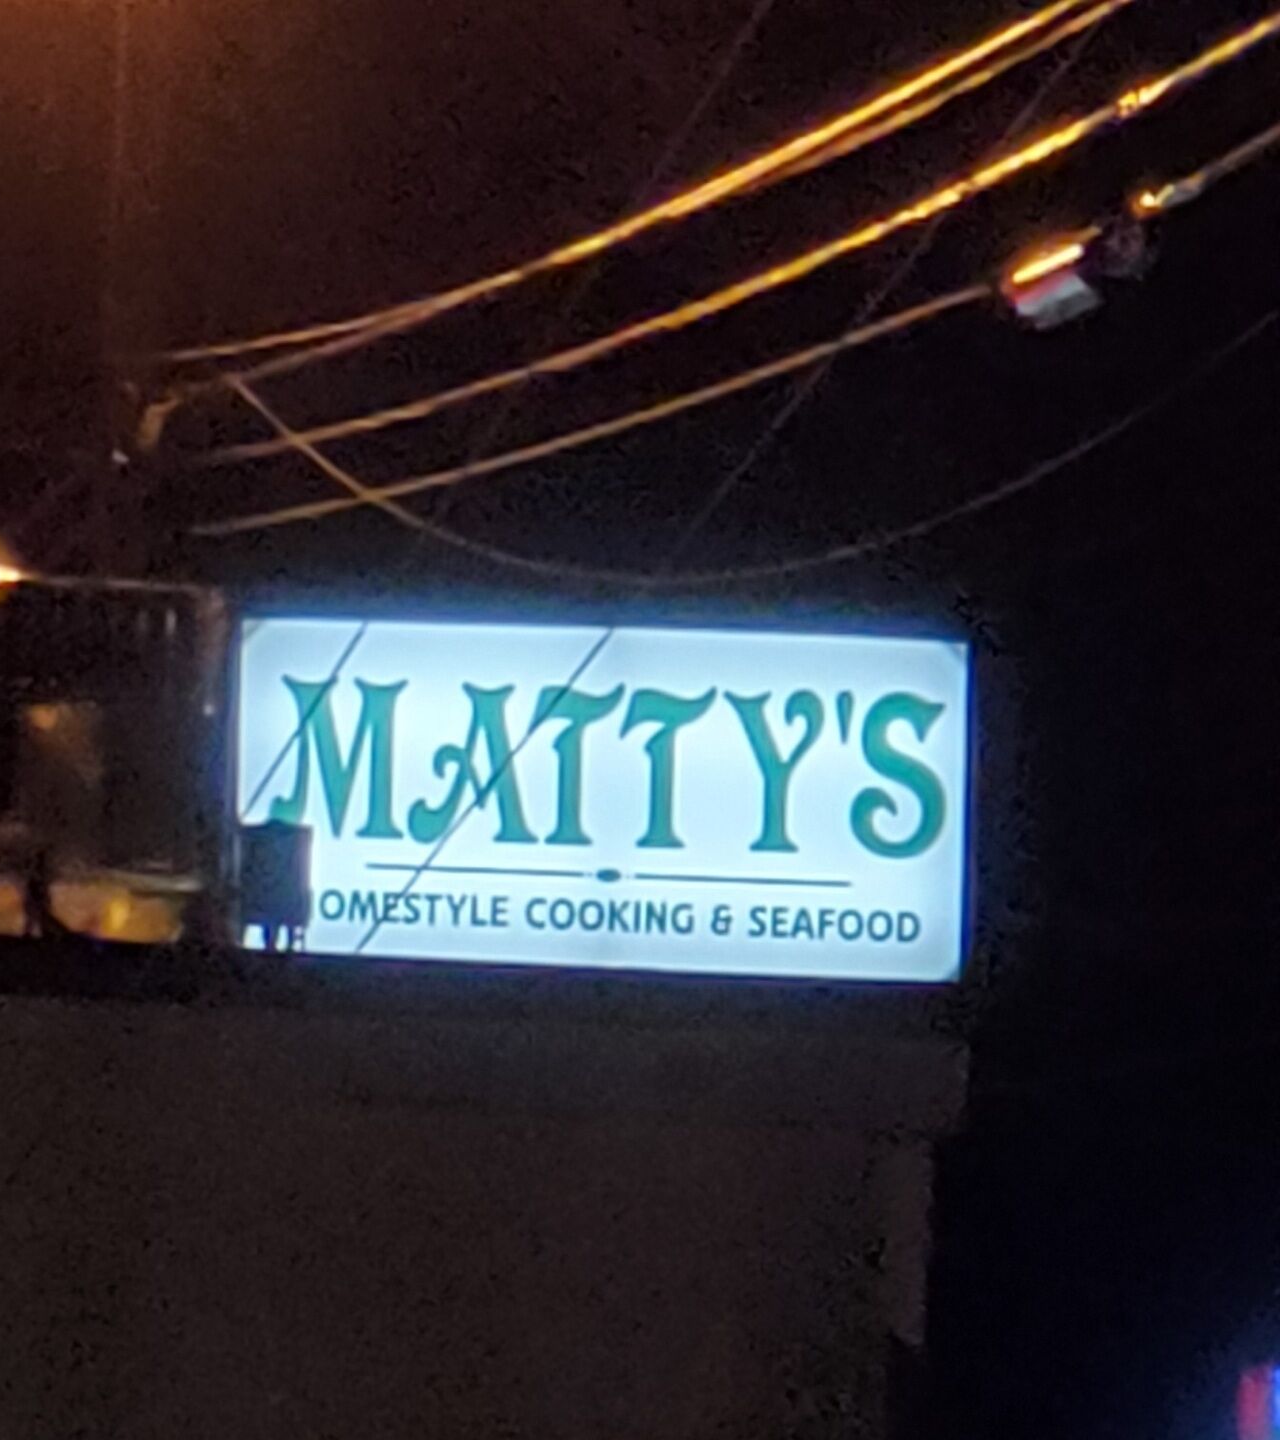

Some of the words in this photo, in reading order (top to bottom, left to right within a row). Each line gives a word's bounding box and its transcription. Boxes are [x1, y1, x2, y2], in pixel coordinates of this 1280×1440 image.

[270, 674, 948, 859] MATTY'S
[318, 888, 510, 929] OMESTYLE
[526, 896, 696, 936] COOKING
[710, 905, 734, 935] &
[749, 905, 922, 943] SEAFOOD
